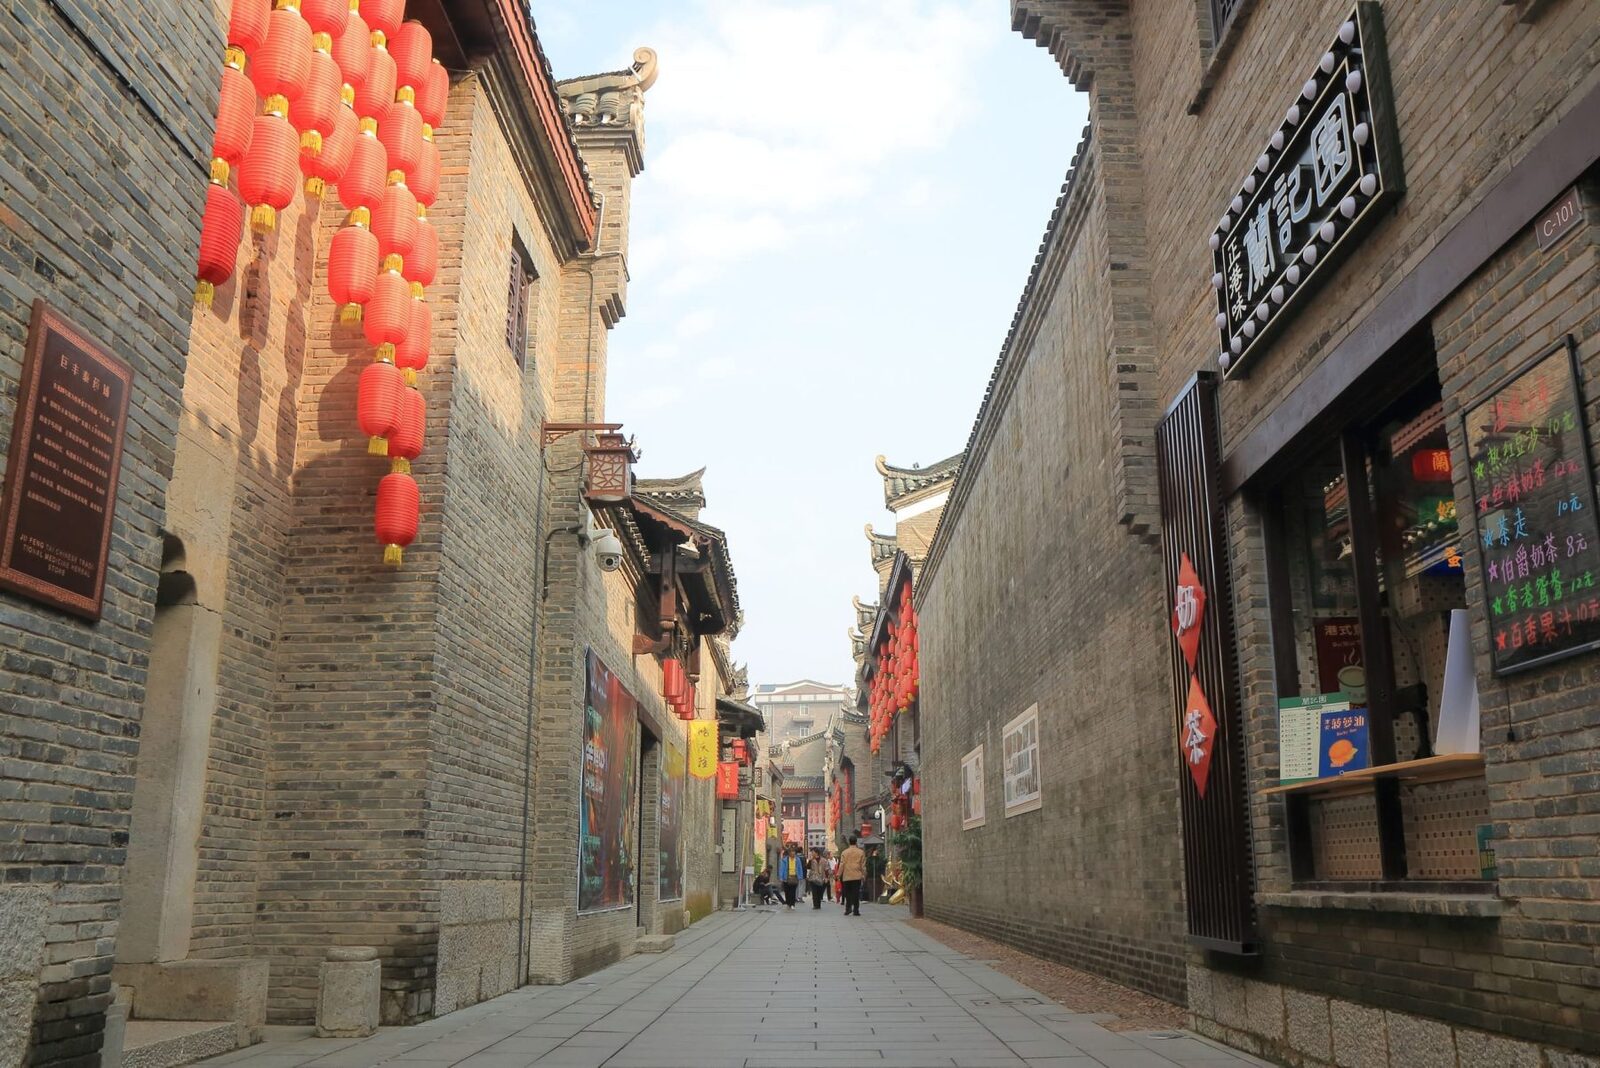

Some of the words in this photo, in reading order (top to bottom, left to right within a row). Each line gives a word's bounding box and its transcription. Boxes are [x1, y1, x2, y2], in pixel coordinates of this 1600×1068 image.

[1243, 93, 1352, 301] 蘭記園
[1543, 201, 1573, 236] C-101
[1227, 236, 1247, 322] 正港味
[1497, 507, 1529, 547] 茶走
[1558, 493, 1582, 516] 10元
[1501, 532, 1558, 585] 伯爵奶茶
[1566, 533, 1588, 558] 8元
[1511, 606, 1573, 648] 百香果汁
